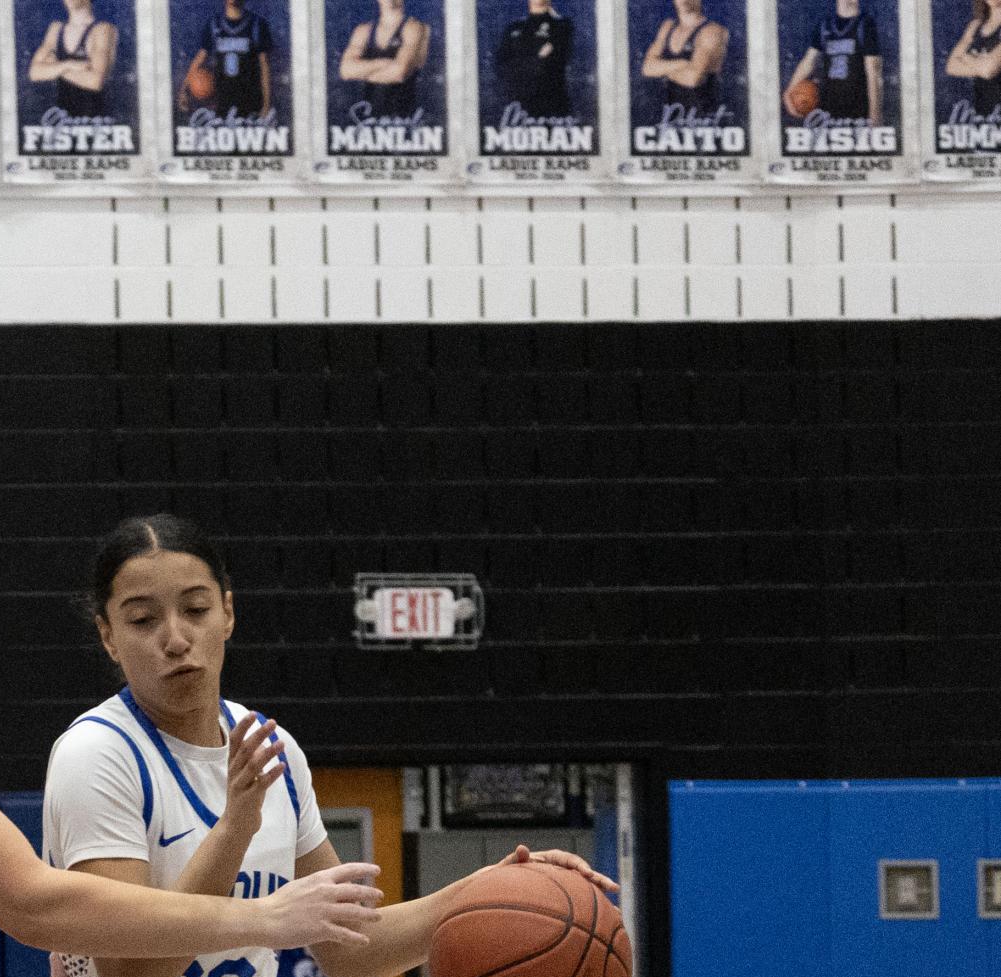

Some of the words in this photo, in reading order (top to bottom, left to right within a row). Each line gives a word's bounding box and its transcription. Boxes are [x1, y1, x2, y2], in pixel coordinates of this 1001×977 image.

[23, 125, 134, 151] FISTER
[176, 126, 289, 151] BROWN
[330, 125, 443, 151] MANLIN
[484, 125, 593, 151] MORAN
[634, 126, 745, 151] CAITO
[785, 127, 896, 151] BISIG
[392, 592, 442, 632] EXIT
